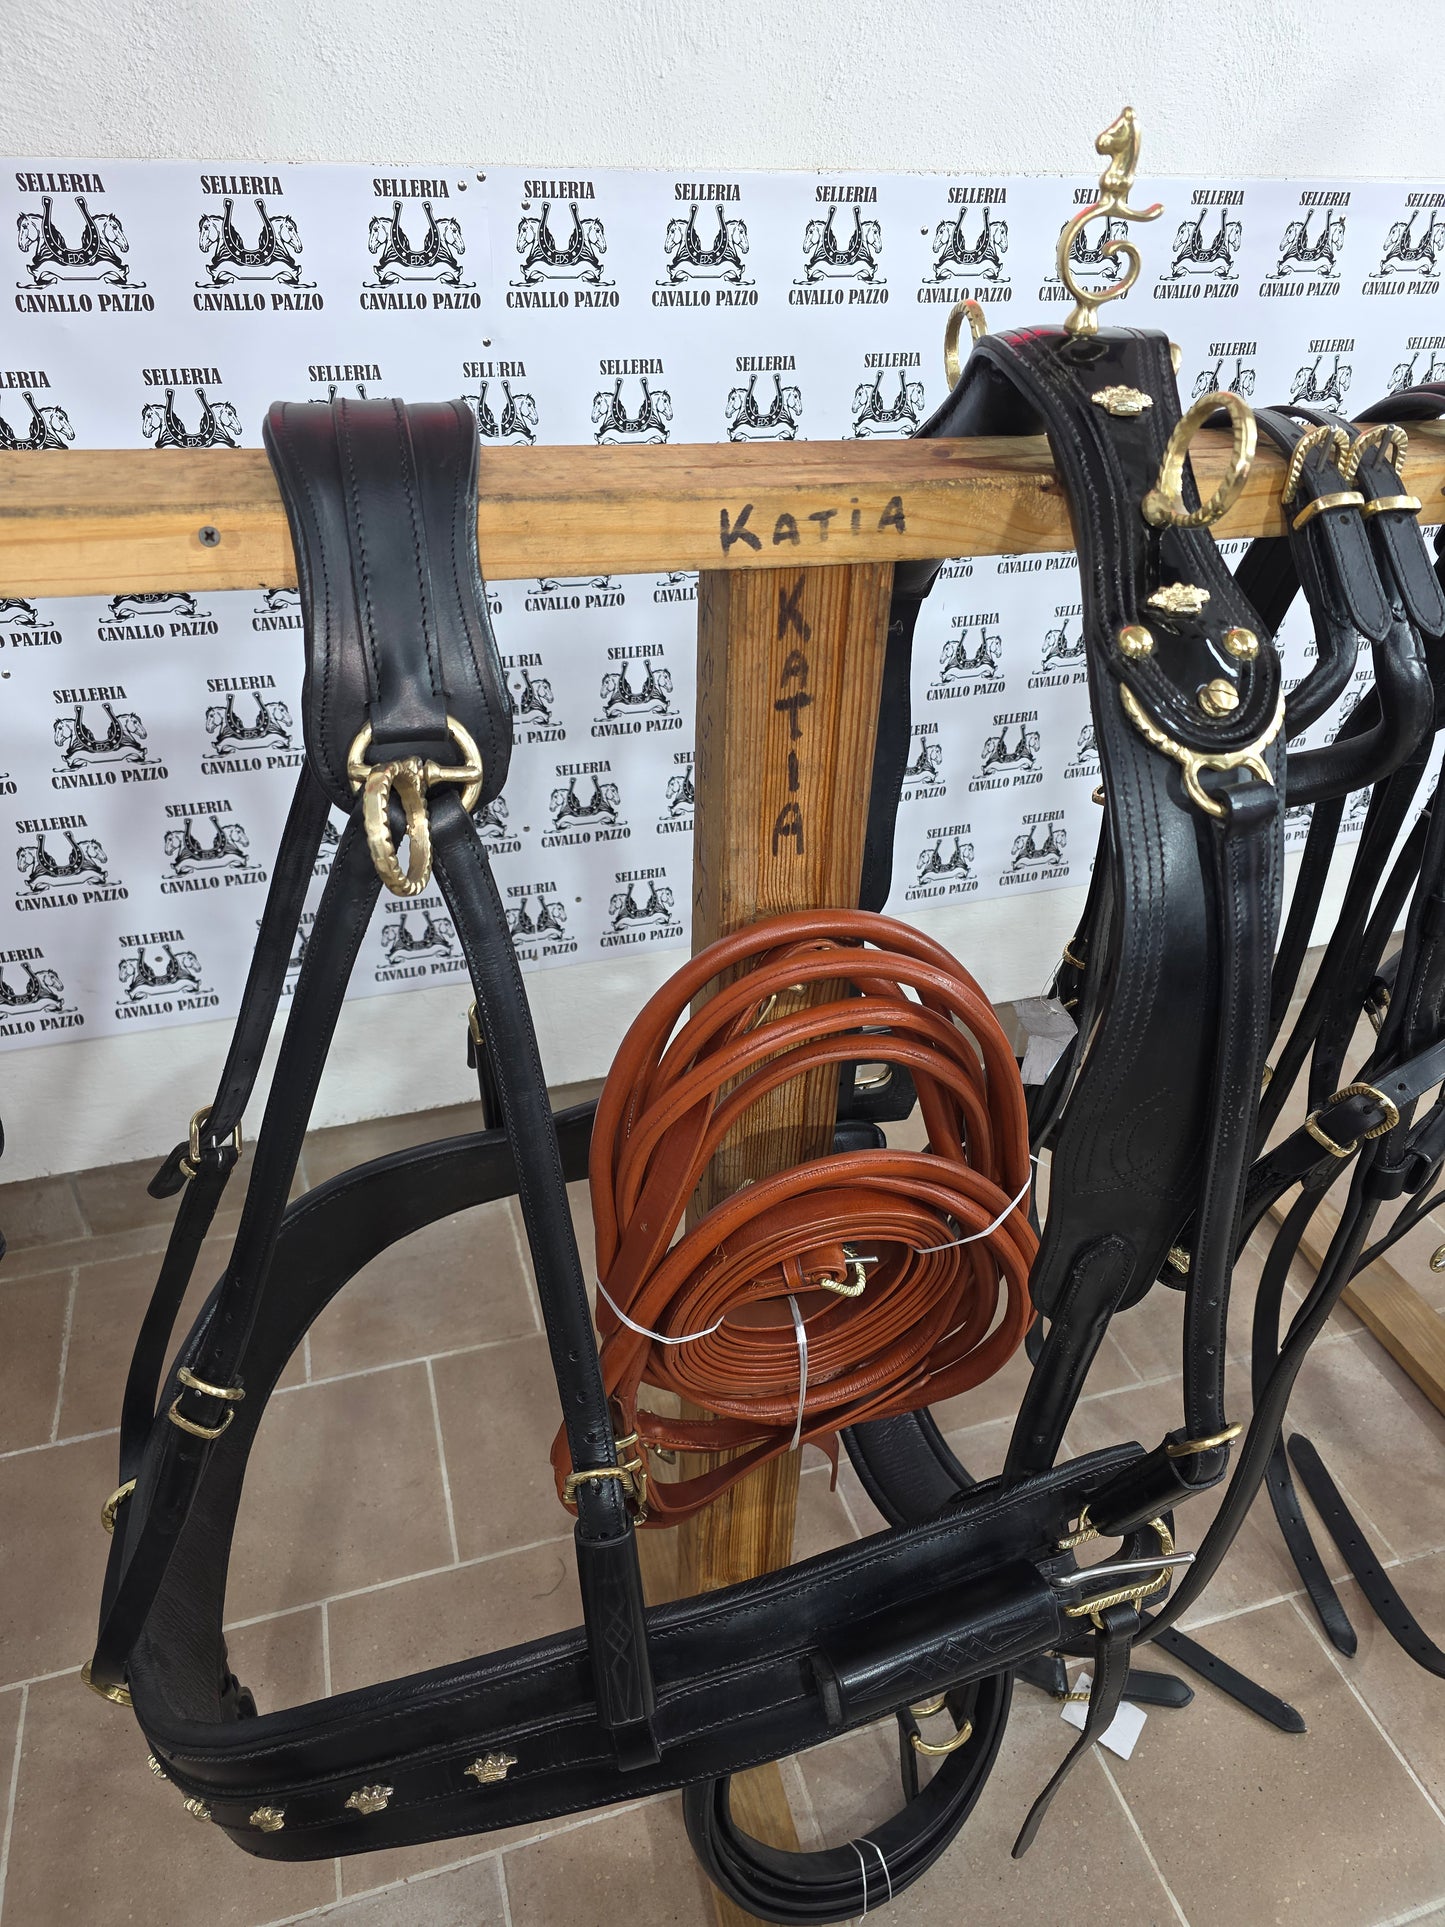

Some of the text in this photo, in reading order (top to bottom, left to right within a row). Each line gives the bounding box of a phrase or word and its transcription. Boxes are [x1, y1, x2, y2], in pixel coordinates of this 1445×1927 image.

[16, 173, 104, 192] SELLERIA
[201, 176, 283, 195] SELLERIA
[373, 179, 449, 198] SELLERIA
[524, 181, 595, 199] SELLERIA
[675, 183, 740, 201] SELLERIA
[816, 186, 877, 202] SELLERIA
[948, 188, 1006, 203] SELLERIA
[1191, 190, 1244, 205] SELLERIA
[1299, 192, 1350, 206] SELLERIA
[1405, 192, 1445, 208] SELLERI
[917, 287, 1012, 304] CAVALLO PAZZO
[1154, 284, 1238, 299] CAVALLO PAZZO
[1259, 282, 1340, 297] CAVALLO PAZZO
[1362, 281, 1439, 295] CAVALLO PAZZO
[15, 294, 154, 312] CAVALLO PAZZO
[194, 294, 323, 311] CAVALLO PAZZO
[360, 293, 481, 309] CAVALLO PAZZO
[506, 291, 619, 308] CAVALLO PAZZO
[652, 290, 758, 306] CAVALLO PAZZO
[789, 289, 888, 305] CAVALLO PAZZO
[1208, 342, 1256, 356] SELLERIA
[1308, 339, 1354, 352] SELLERIA
[1405, 336, 1445, 350] SELLERI
[600, 359, 663, 375] SELLERIA
[736, 356, 795, 371] SELLERIA
[864, 353, 920, 367] SELLERIA
[143, 368, 222, 385] SELLERIA
[309, 365, 382, 381] SELLERIA
[462, 361, 526, 378] SELLRIA
[939, 565, 973, 579] PAZZO
[997, 557, 1078, 574] CAVALLO PAZZO
[525, 593, 625, 611] CAVALLO PAZZO
[653, 587, 698, 604] CAVALL
[1054, 604, 1084, 618] SELLE
[252, 615, 305, 632] CAVALL
[952, 613, 999, 628] SELLERIA
[11, 631, 62, 647] PAZZO
[98, 621, 218, 641] CAVALLO PAZZO
[499, 652, 543, 669] LLRIA
[608, 644, 664, 661] SELLERIA
[207, 675, 275, 693] SELLERIA
[1028, 674, 1069, 688] CAVALLO
[53, 686, 126, 705] SELLERIA
[927, 682, 1005, 701] CAVALLO PAZZO
[772, 573, 813, 858] KATIA
[993, 711, 1037, 726] SELLERIA
[527, 726, 566, 743] PAZZO
[591, 718, 682, 737] CAVALLO PAZZO
[1288, 734, 1306, 748] ZZO
[201, 757, 261, 775] CAVALLO
[556, 761, 611, 777] SELLERIA
[52, 767, 168, 789] CAVALLO PAZZO
[969, 773, 1043, 792] CAVALLO PAZZO
[916, 784, 946, 799] PAZZO
[165, 800, 232, 818] SELLERIA
[1023, 810, 1064, 825] SELLERIA
[16, 815, 87, 833] SELLERIA
[656, 819, 694, 834] CAVALL
[927, 824, 970, 839] SELLERIA
[541, 825, 630, 847] CAVALLO PAZZO
[484, 838, 521, 855] PAZZO
[161, 872, 267, 894] CAVALLO PAZZO
[615, 867, 666, 884] SELLERIA
[999, 867, 1069, 886] CAVALLO PAZZO
[507, 880, 557, 898] SELLRIA
[905, 881, 978, 900] CAVALLO PAZZO
[15, 886, 128, 911] CAVALLO PAZZO
[385, 896, 444, 914] SELLERIA
[119, 930, 184, 948] SELLERIA
[600, 925, 683, 947] CAVALLO PAZZO
[543, 940, 577, 956] PAZZO
[375, 958, 468, 981] CAVALLO PAZZO
[115, 994, 219, 1019] CAVALLO PAZZO
[40, 1012, 84, 1030] PAZZO
